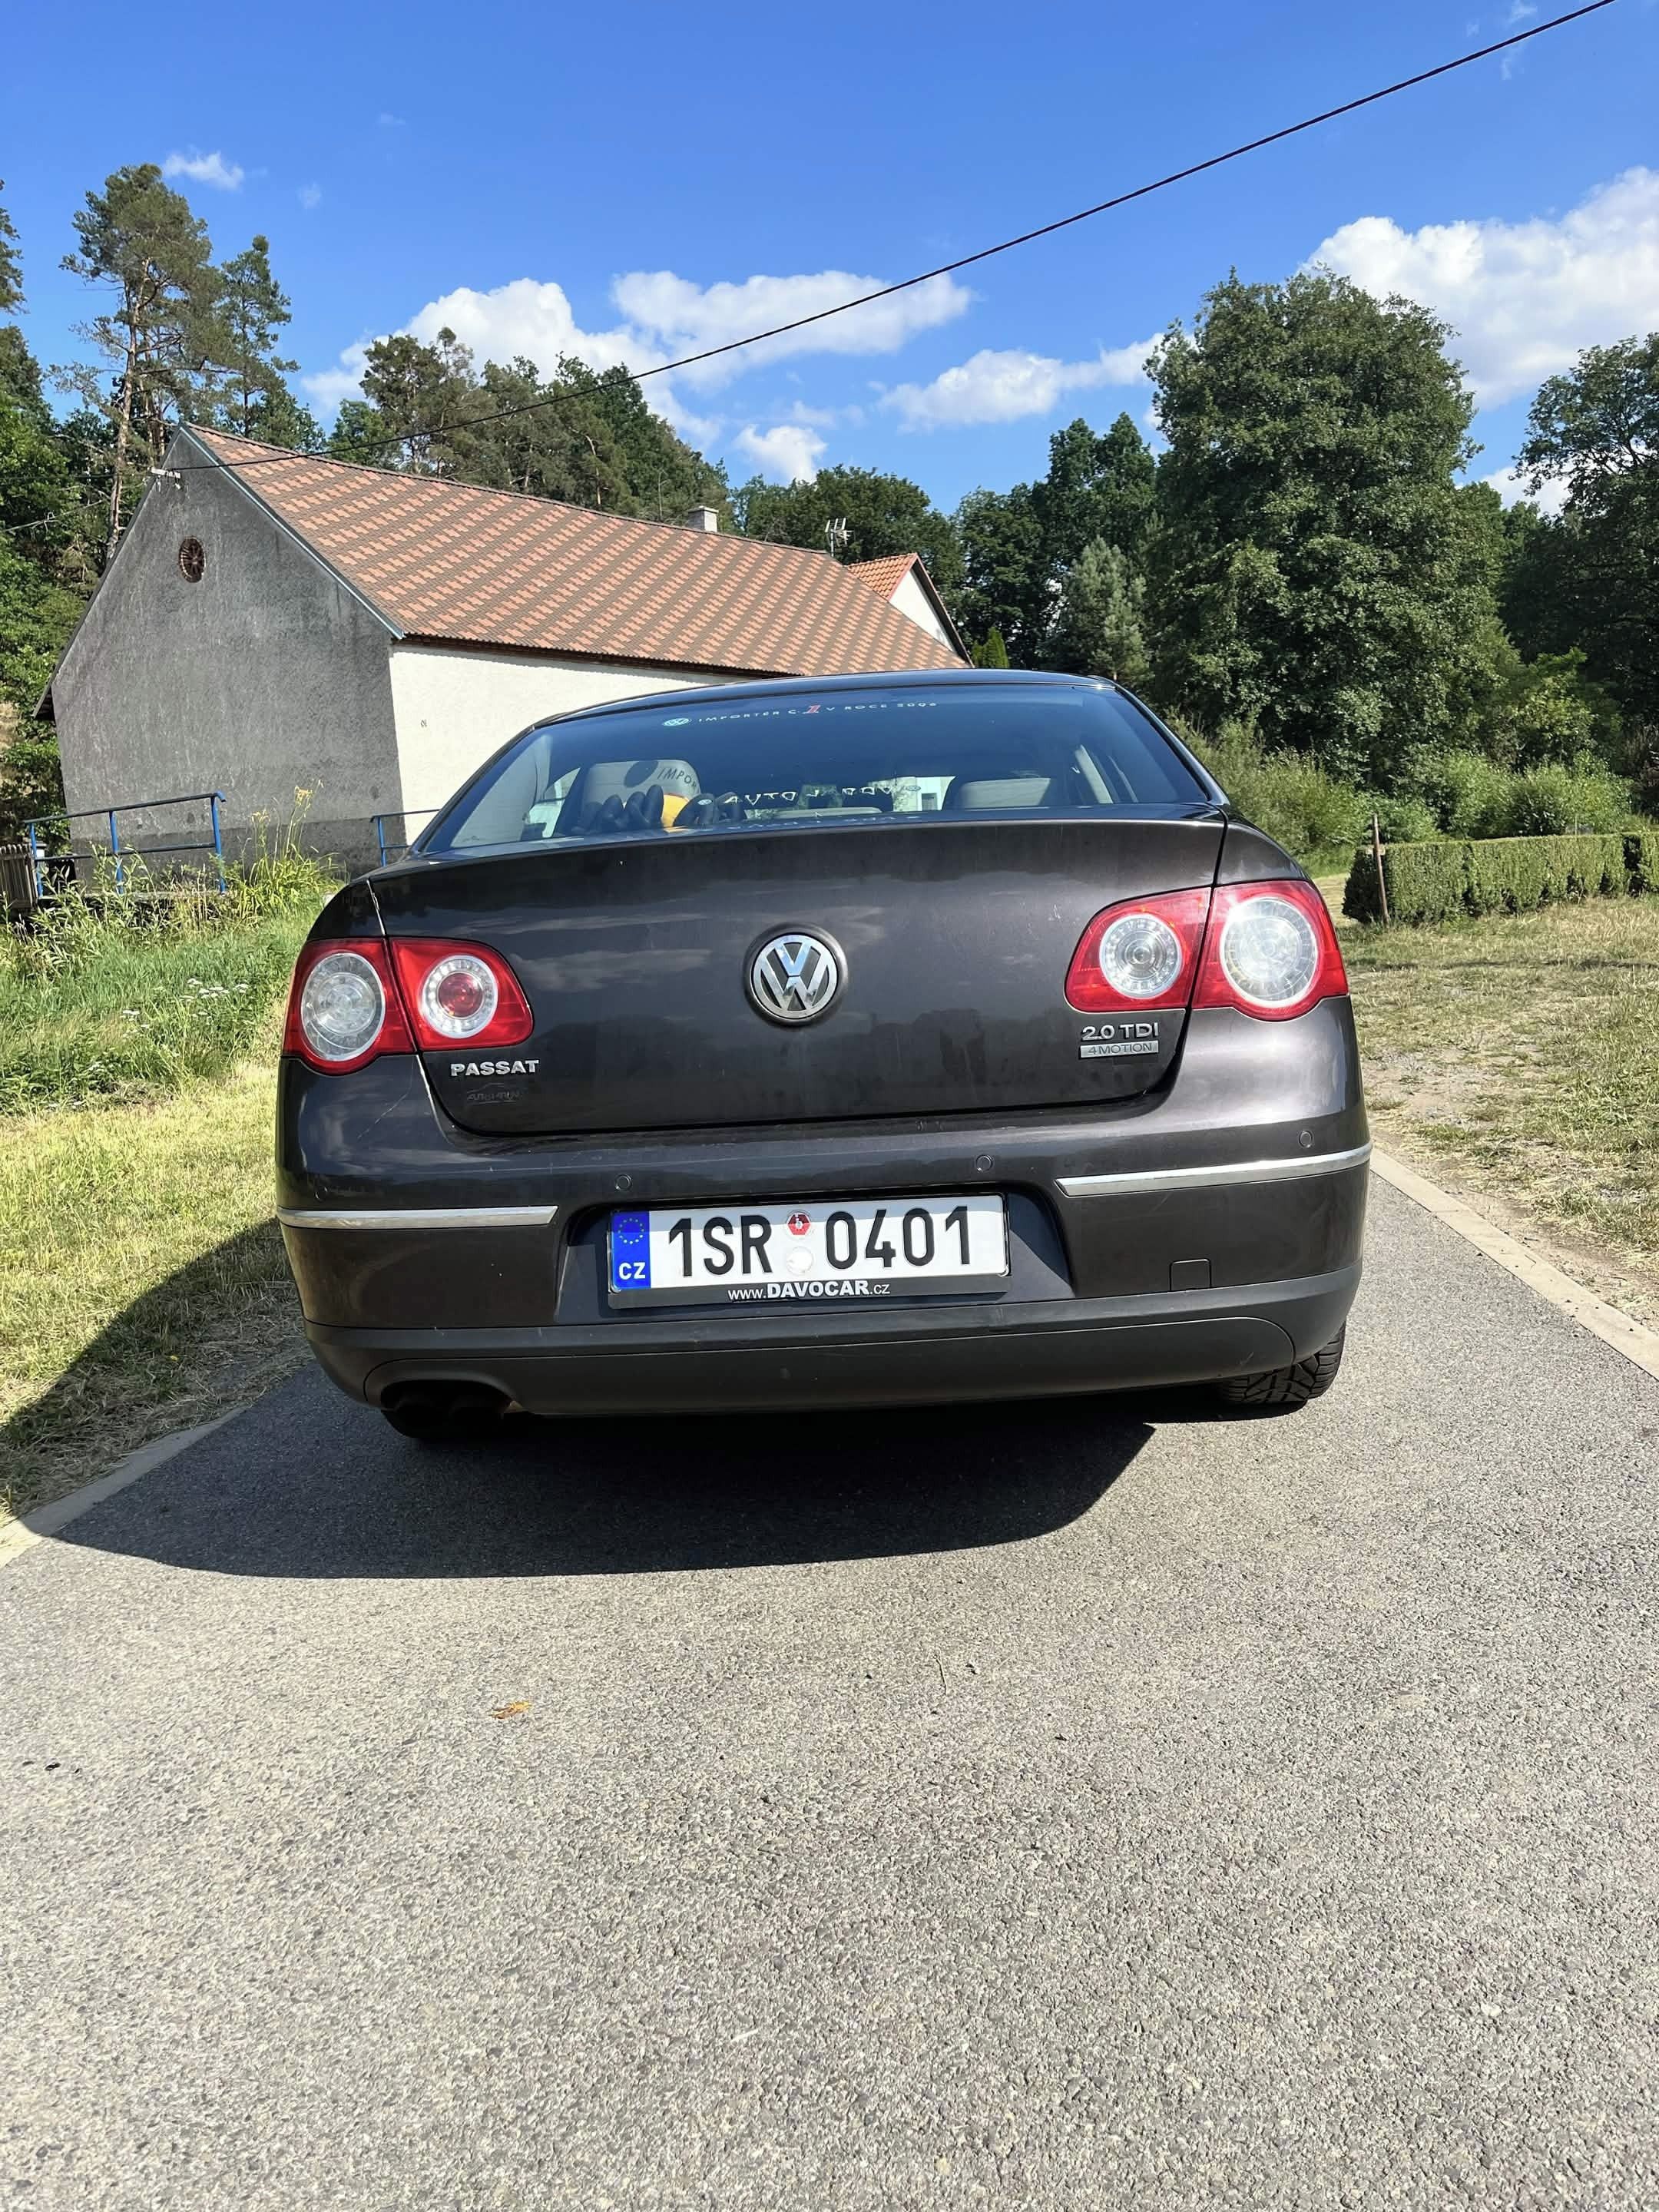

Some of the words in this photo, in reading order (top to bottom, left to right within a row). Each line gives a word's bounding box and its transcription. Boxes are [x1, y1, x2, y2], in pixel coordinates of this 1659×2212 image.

[698, 710, 780, 723] IMPORTER
[1119, 1022, 1159, 1038] TDI
[1088, 1041, 1153, 1055] 4MOTION
[450, 1059, 539, 1077] PASSAT
[668, 1214, 773, 1278] 1SR
[826, 1205, 972, 1270] 0401
[618, 1261, 647, 1281] CZ
